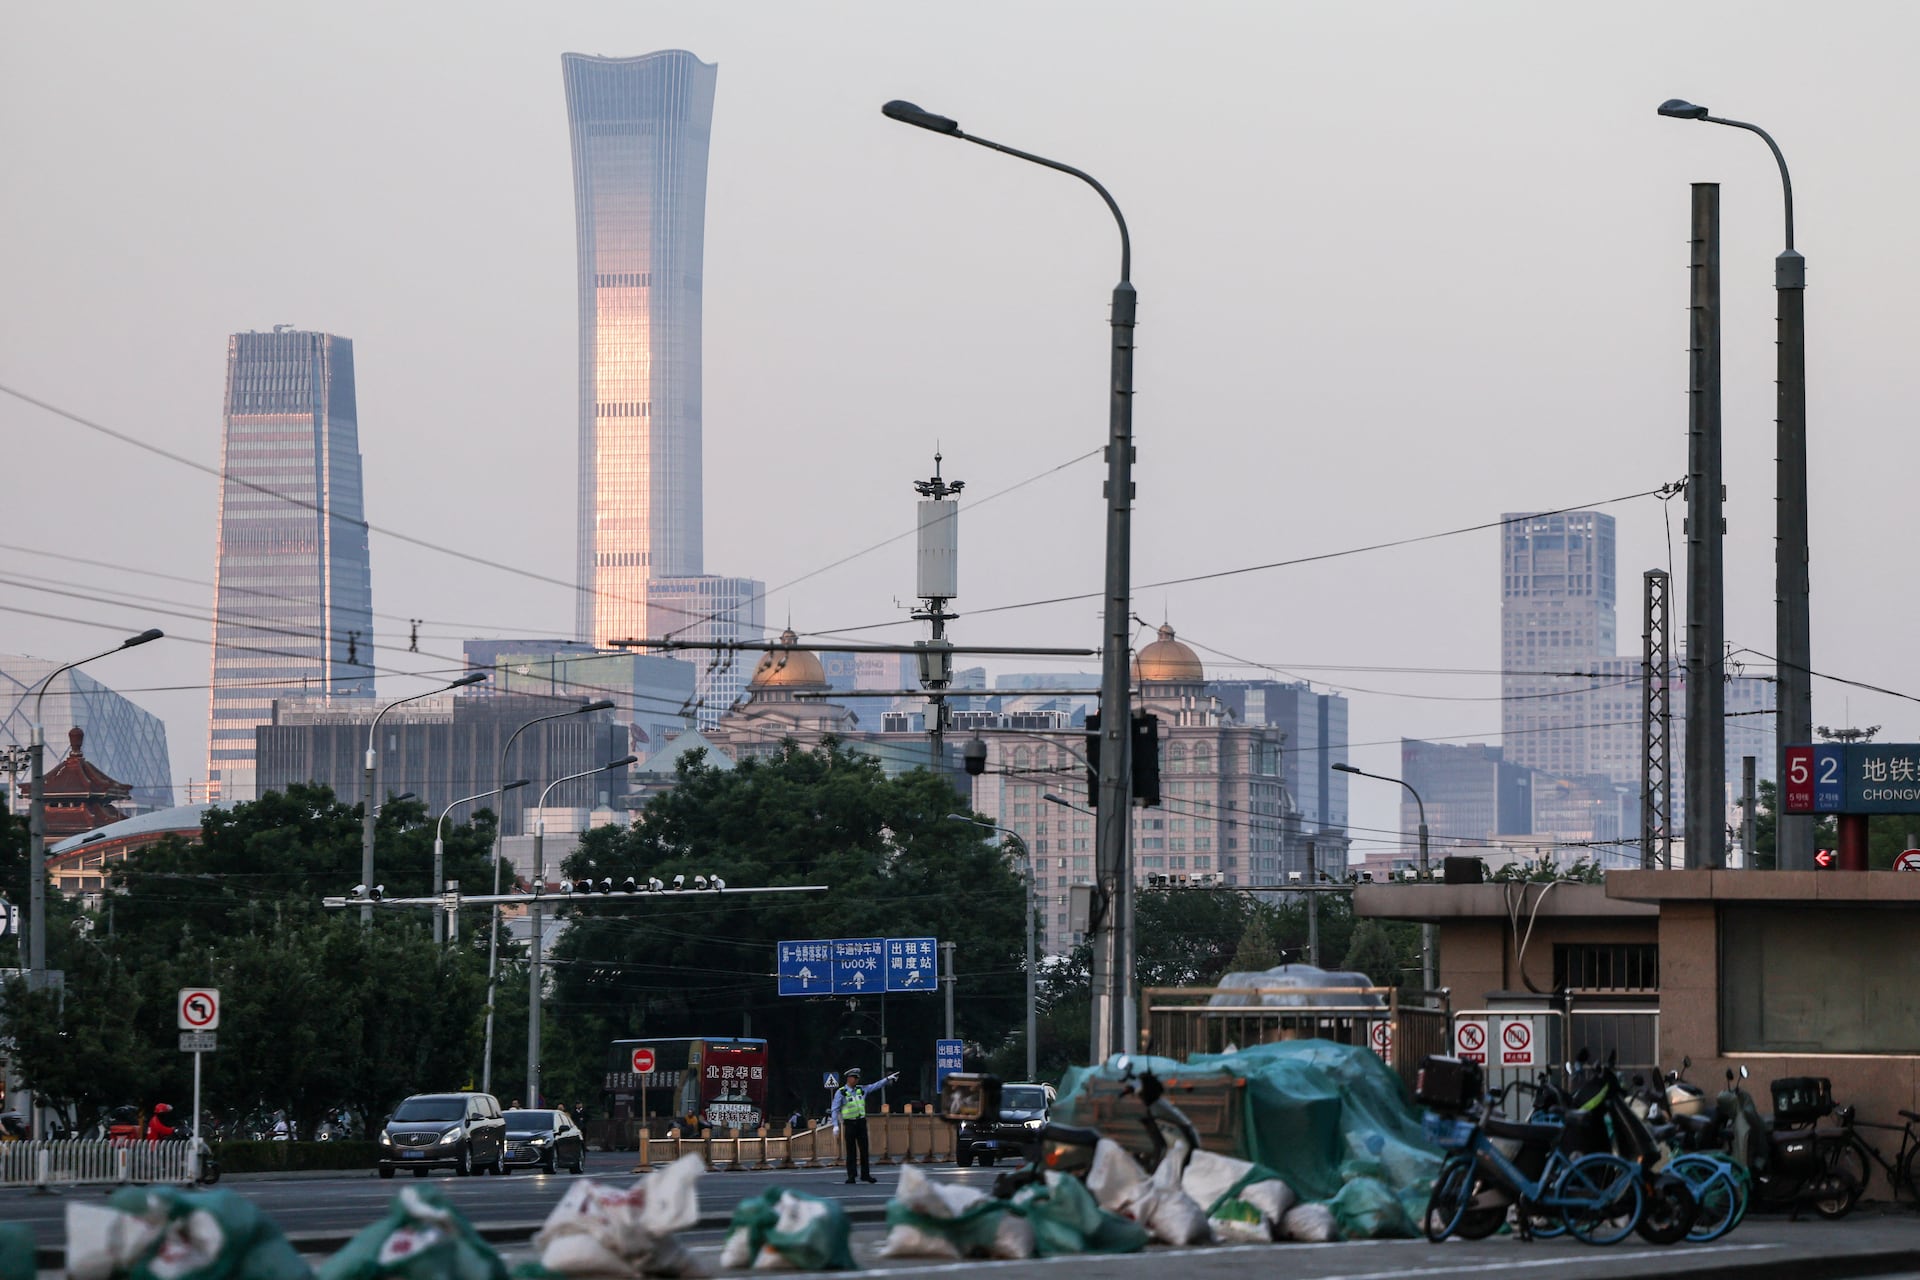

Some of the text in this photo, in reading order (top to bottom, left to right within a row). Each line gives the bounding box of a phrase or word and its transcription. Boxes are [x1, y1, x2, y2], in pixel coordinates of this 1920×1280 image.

[648, 584, 697, 593] SAMSUNG
[1790, 757, 1838, 784] 5 2
[1862, 757, 1920, 782] 地铁
[891, 942, 931, 955] 出租车
[841, 957, 877, 970] 1000米
[891, 957, 932, 969] 调度站
[938, 1045, 961, 1055] 出租车
[706, 1065, 763, 1080] 北京华医
